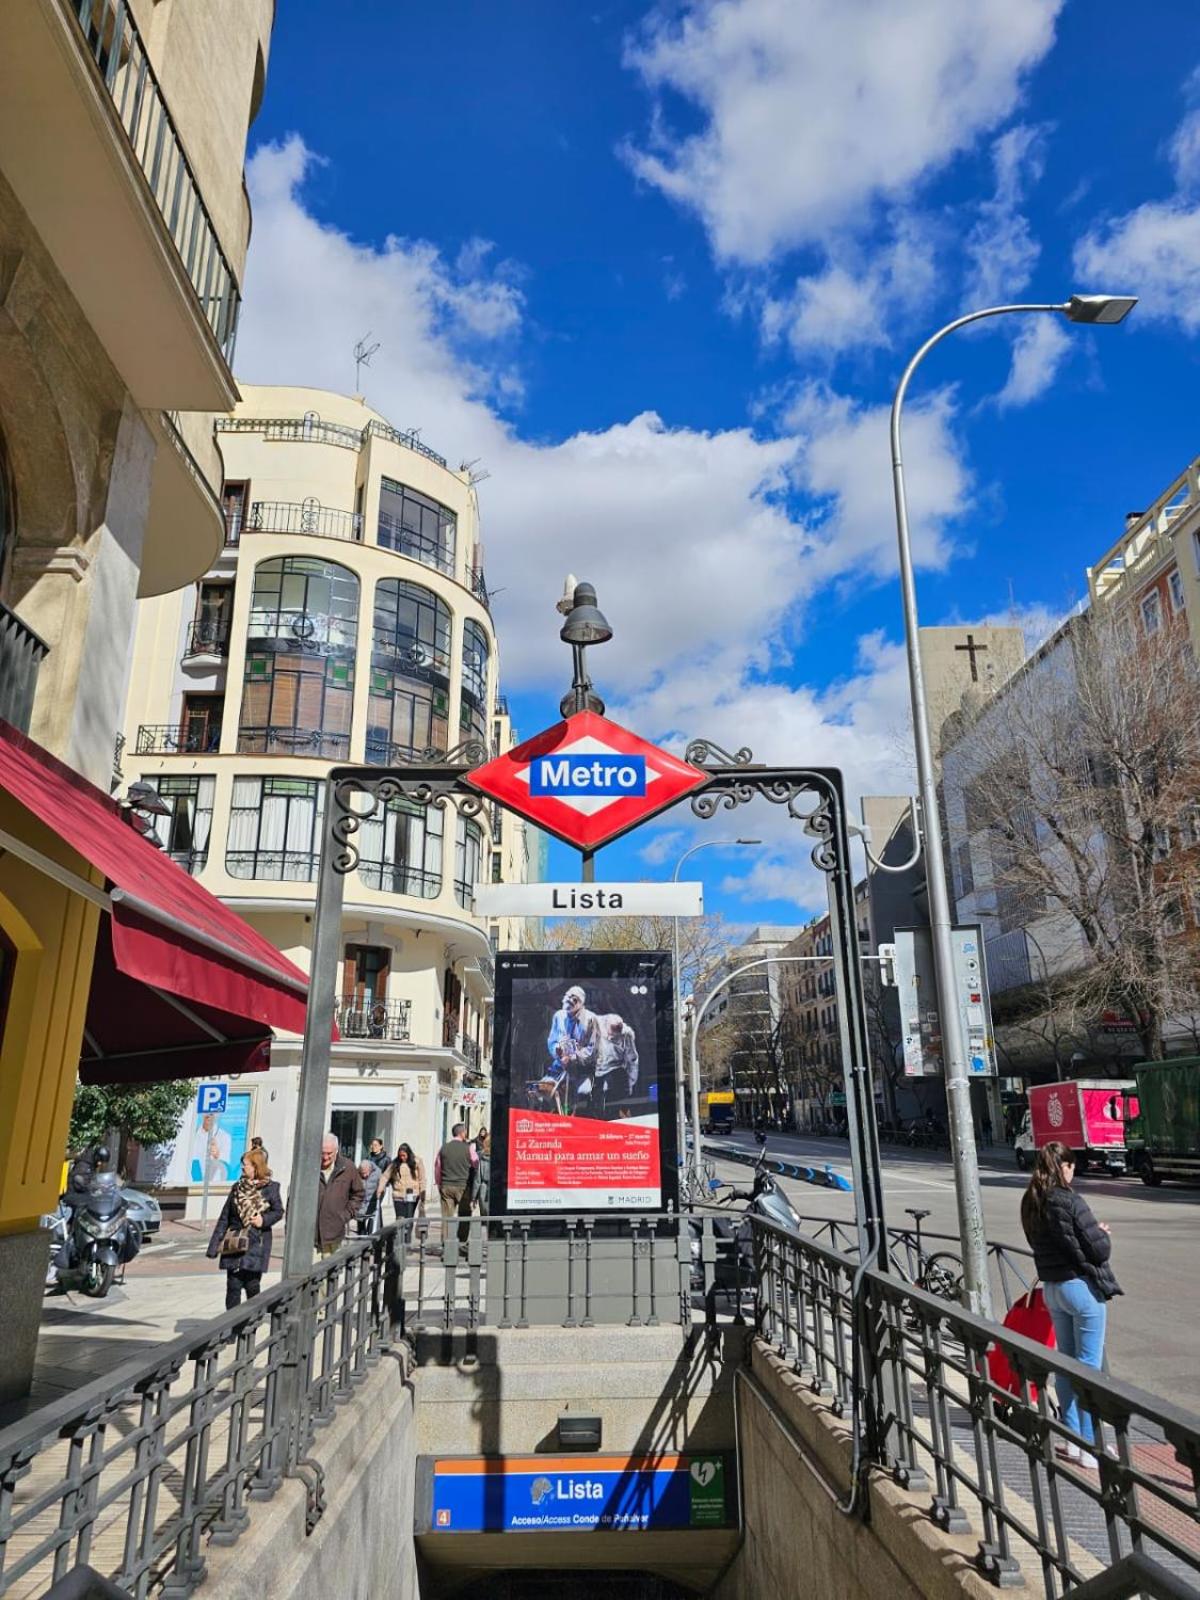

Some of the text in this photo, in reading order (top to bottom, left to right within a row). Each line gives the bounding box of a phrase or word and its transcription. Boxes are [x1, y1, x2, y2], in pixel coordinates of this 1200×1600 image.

[541, 760, 637, 787] Metro
[552, 889, 624, 909] Lista
[202, 1087, 222, 1111] P
[516, 1139, 562, 1149] La Zaranda
[515, 1150, 650, 1163] Manual para armar un sueño
[619, 1196, 652, 1204] MADRID
[557, 1479, 603, 1499] Lista
[439, 1511, 447, 1524] 4
[511, 1515, 571, 1526] Acceso/Access
[573, 1514, 599, 1524] Conde
[601, 1514, 611, 1524] de
